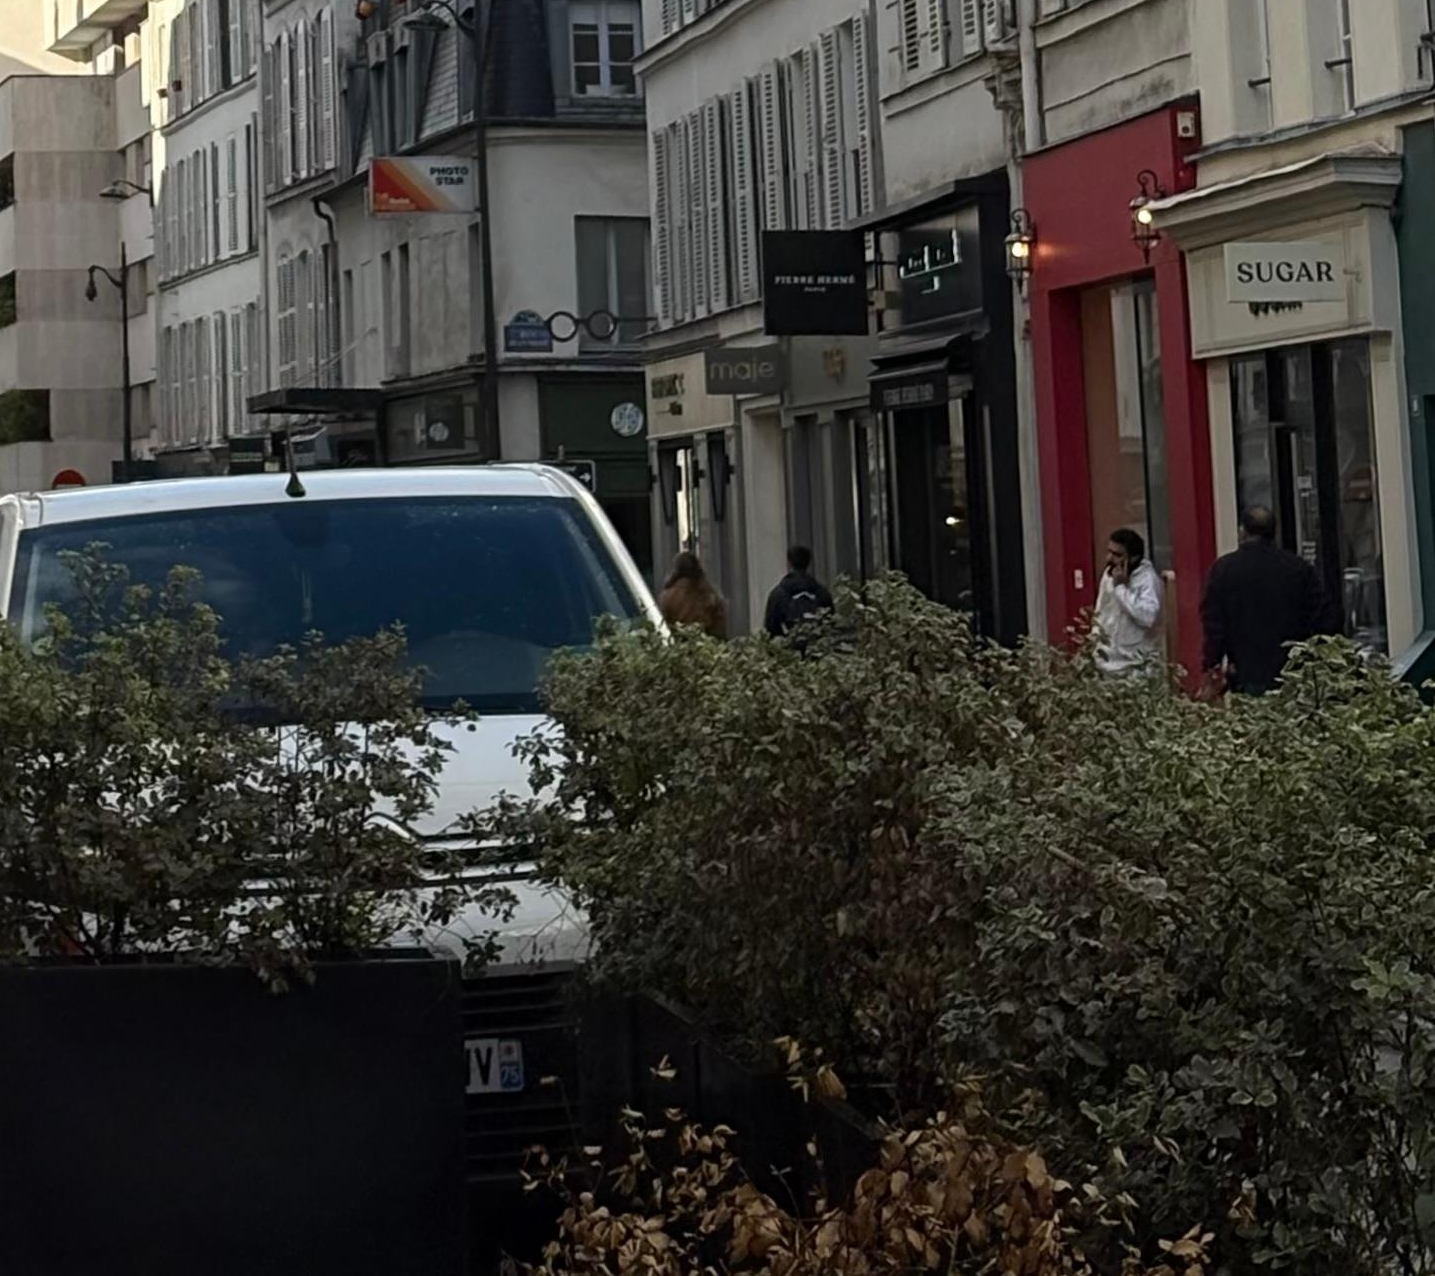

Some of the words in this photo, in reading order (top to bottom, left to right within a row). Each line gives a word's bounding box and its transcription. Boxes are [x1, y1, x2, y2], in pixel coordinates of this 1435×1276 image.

[429, 166, 469, 176] PHOTO
[435, 177, 464, 186] STAR
[1236, 261, 1335, 284] SUGAR
[773, 275, 814, 286] PIERRE
[709, 357, 775, 383] maje
[501, 1065, 519, 1084] 75
